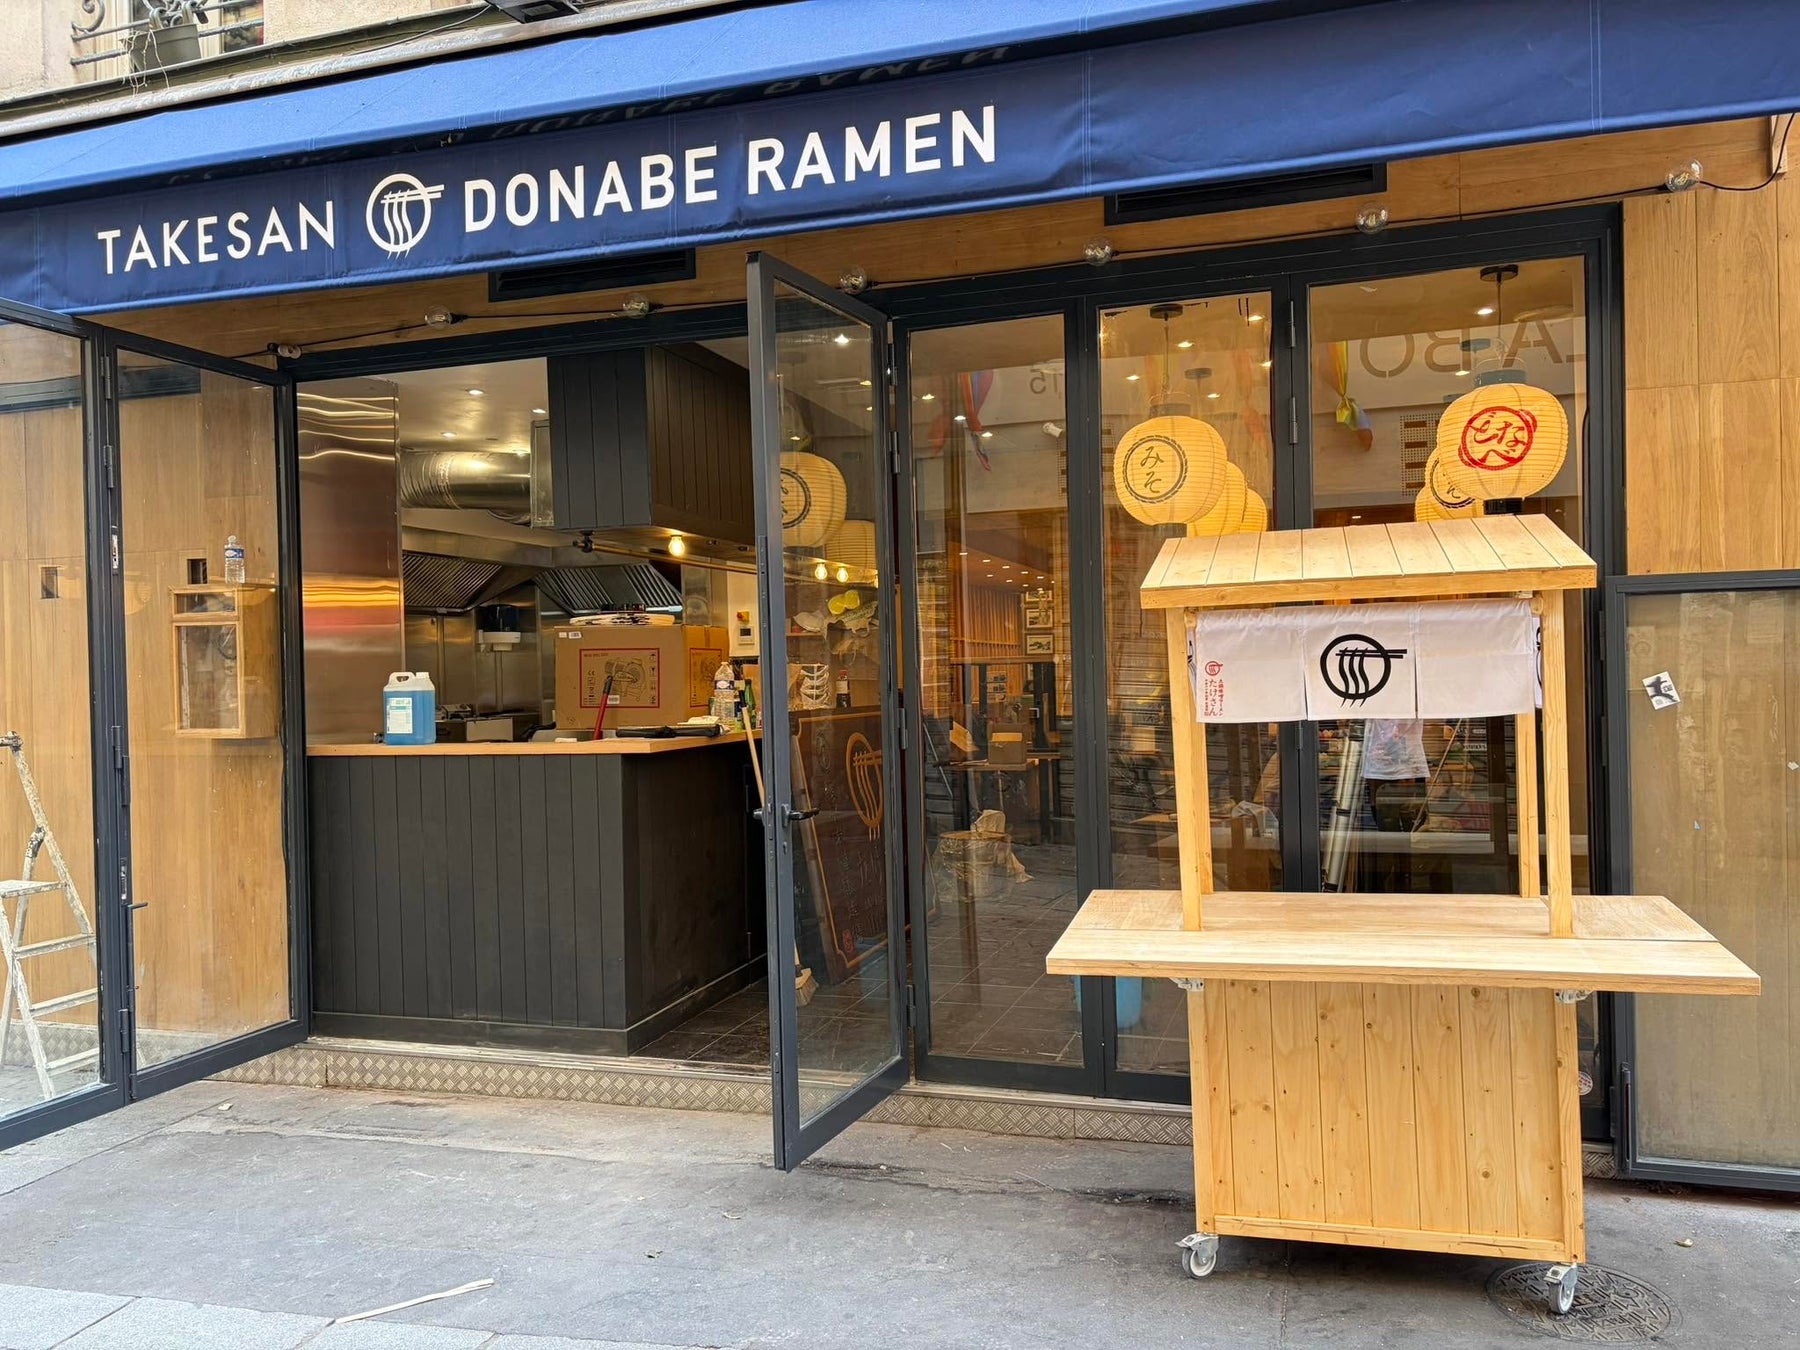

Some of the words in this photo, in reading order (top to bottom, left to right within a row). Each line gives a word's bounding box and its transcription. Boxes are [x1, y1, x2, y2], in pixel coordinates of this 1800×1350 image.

[97, 200, 335, 275] TAKESAN
[464, 145, 718, 233] DONABE
[747, 105, 996, 195] RAMEN
[1140, 445, 1164, 494] みそ
[1208, 678, 1219, 717] たけさん
